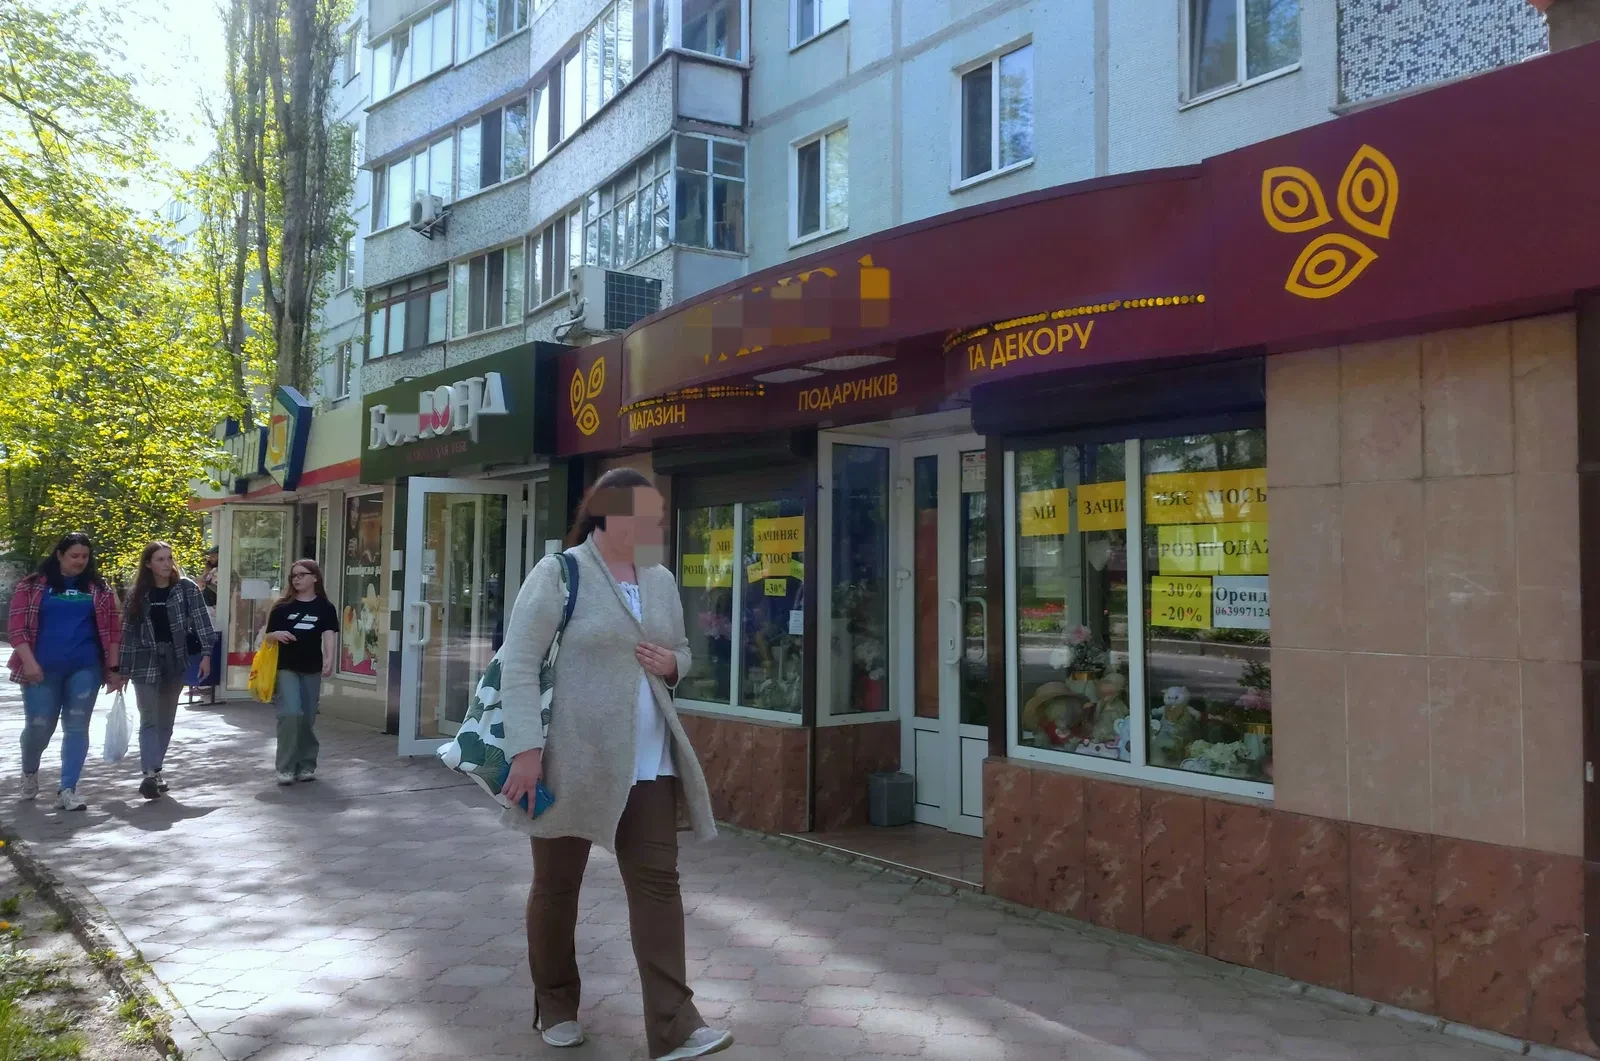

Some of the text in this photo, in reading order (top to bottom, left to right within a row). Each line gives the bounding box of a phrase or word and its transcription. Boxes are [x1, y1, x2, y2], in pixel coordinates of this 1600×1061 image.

[967, 320, 1095, 371] ТА ДЕКОРУ
[798, 373, 898, 411] ПОДАРУНКІВ
[629, 404, 686, 432] МАГАЗИН
[1033, 505, 1056, 519] МИ
[1162, 582, 1202, 599] -30%
[1162, 606, 1202, 622] -20%
